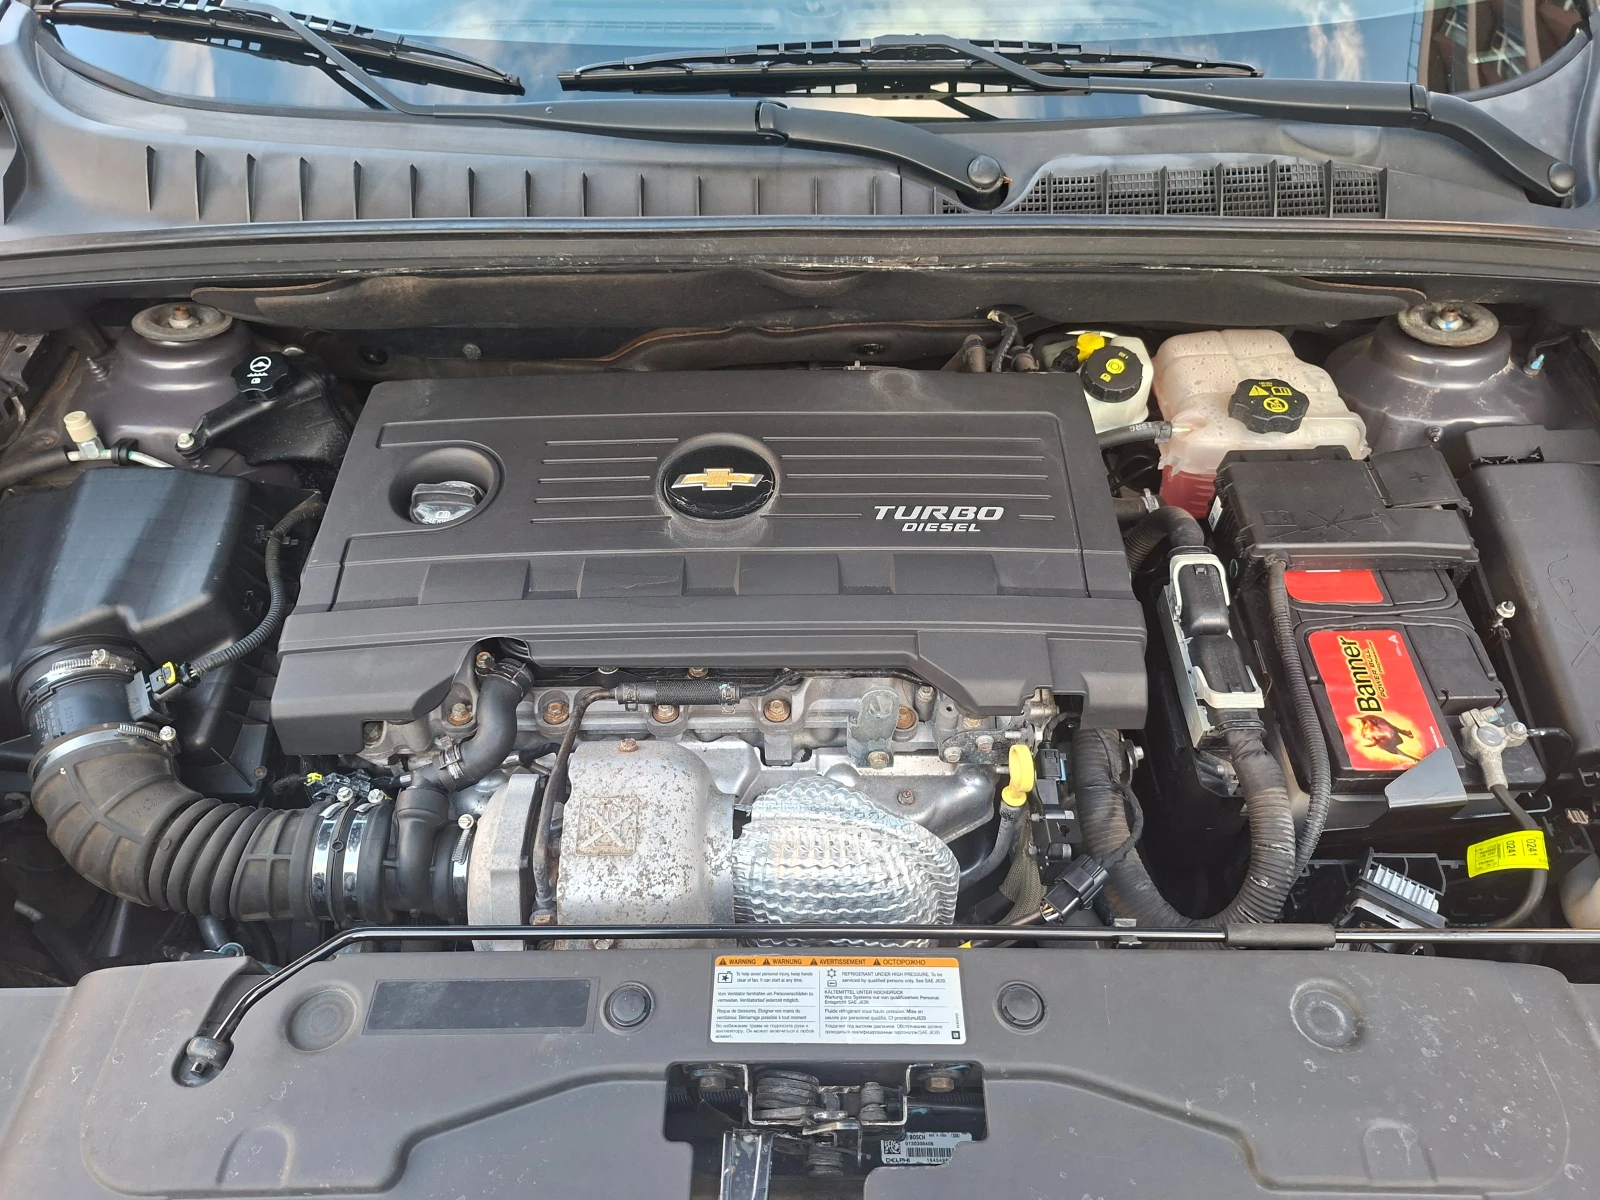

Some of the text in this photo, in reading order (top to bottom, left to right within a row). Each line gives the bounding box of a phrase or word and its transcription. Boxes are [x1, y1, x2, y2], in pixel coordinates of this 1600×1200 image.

[874, 505, 1005, 521] TURBO
[901, 522, 981, 532] DIESEL
[1338, 636, 1382, 712] Banner
[1364, 649, 1387, 698] POWER BULL
[1506, 840, 1517, 857] 0241
[1526, 838, 1538, 856] 0241
